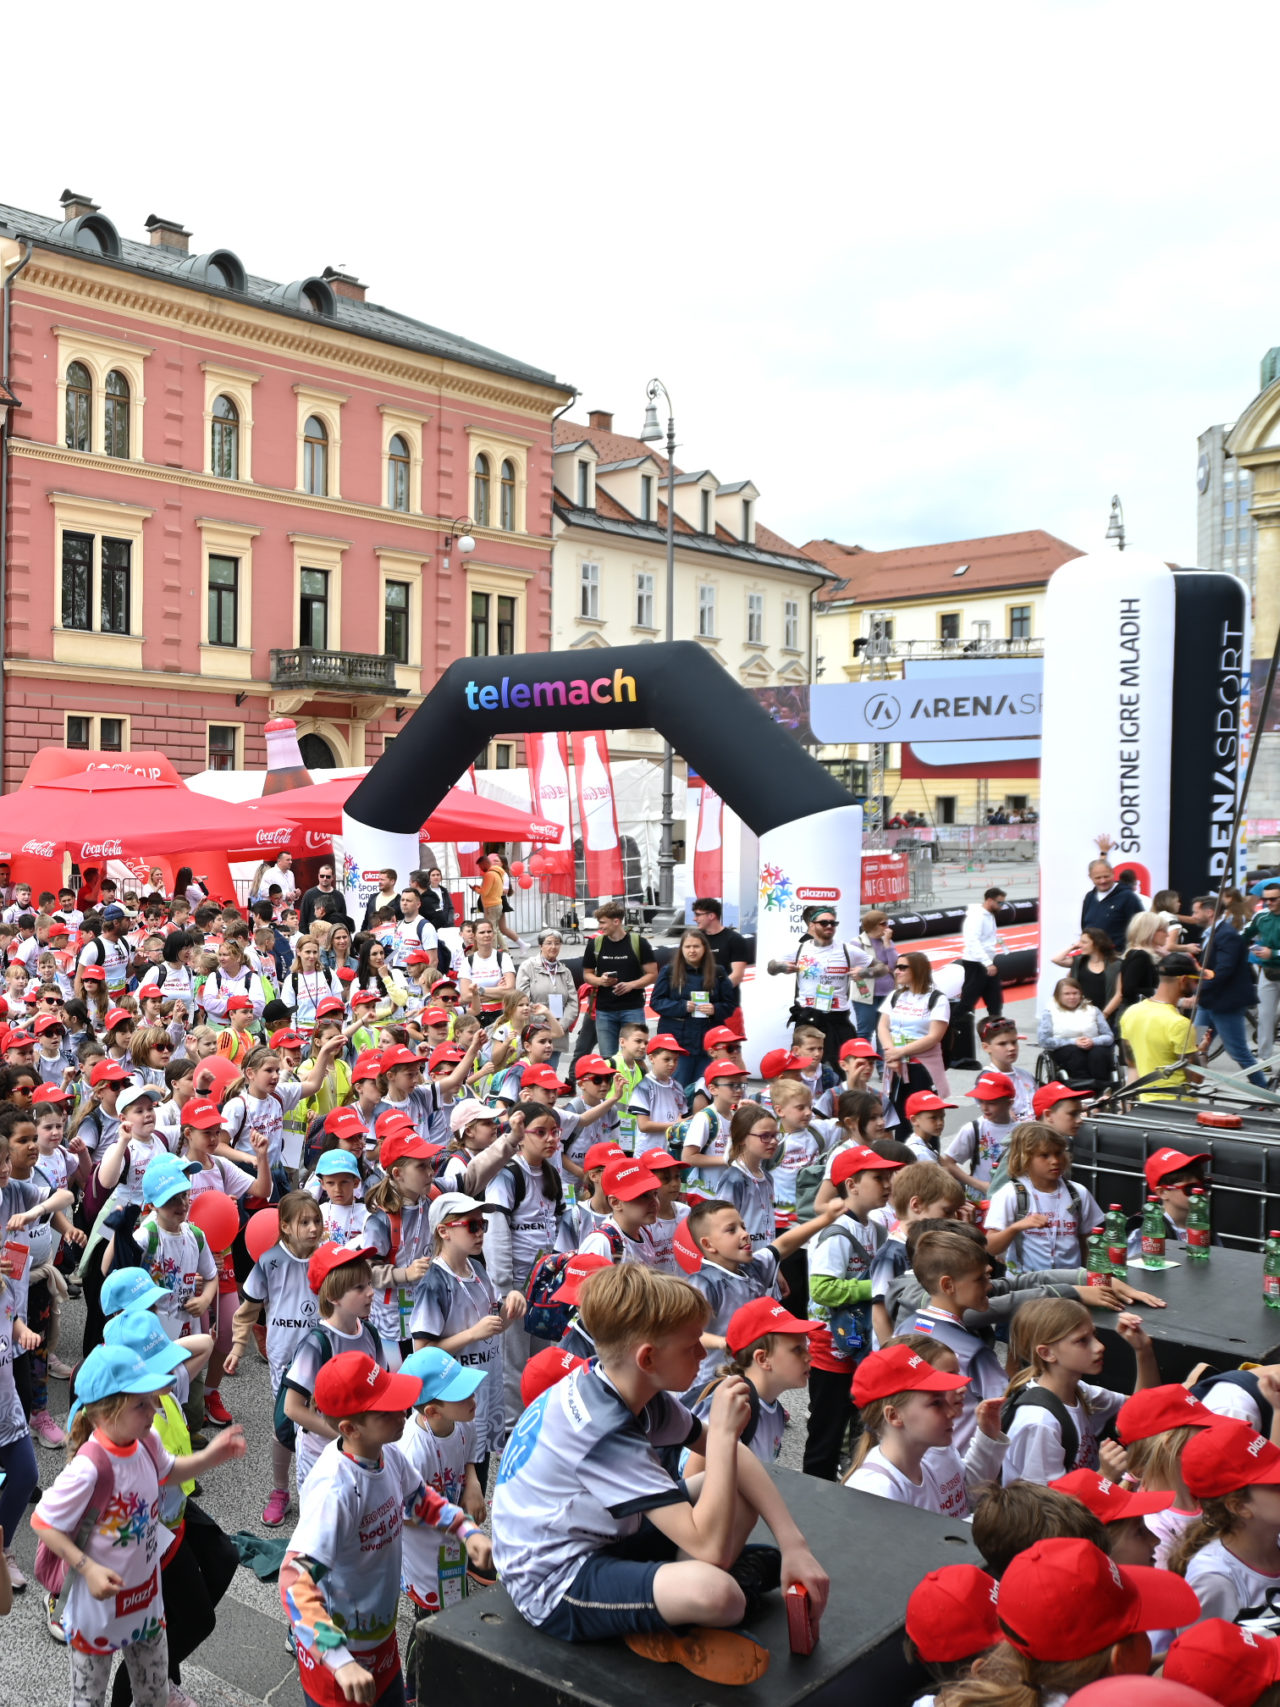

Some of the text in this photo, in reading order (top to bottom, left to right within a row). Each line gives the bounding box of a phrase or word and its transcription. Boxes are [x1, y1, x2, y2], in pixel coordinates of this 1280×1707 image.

[465, 669, 637, 711] telemach
[1113, 598, 1141, 853] ŠPORTNE IGRE MLADIH
[256, 828, 295, 845] Coca-Cola
[22, 839, 57, 858] Coca-Cola
[81, 839, 123, 858] Coca-Cola
[800, 889, 836, 898] plazma
[616, 1166, 640, 1181] plazma
[770, 1305, 787, 1318] plaz
[366, 1364, 381, 1387] plaz
[1247, 1434, 1268, 1458] plaz
[359, 1510, 399, 1544] bodi del
[123, 1578, 155, 1610] plaz
